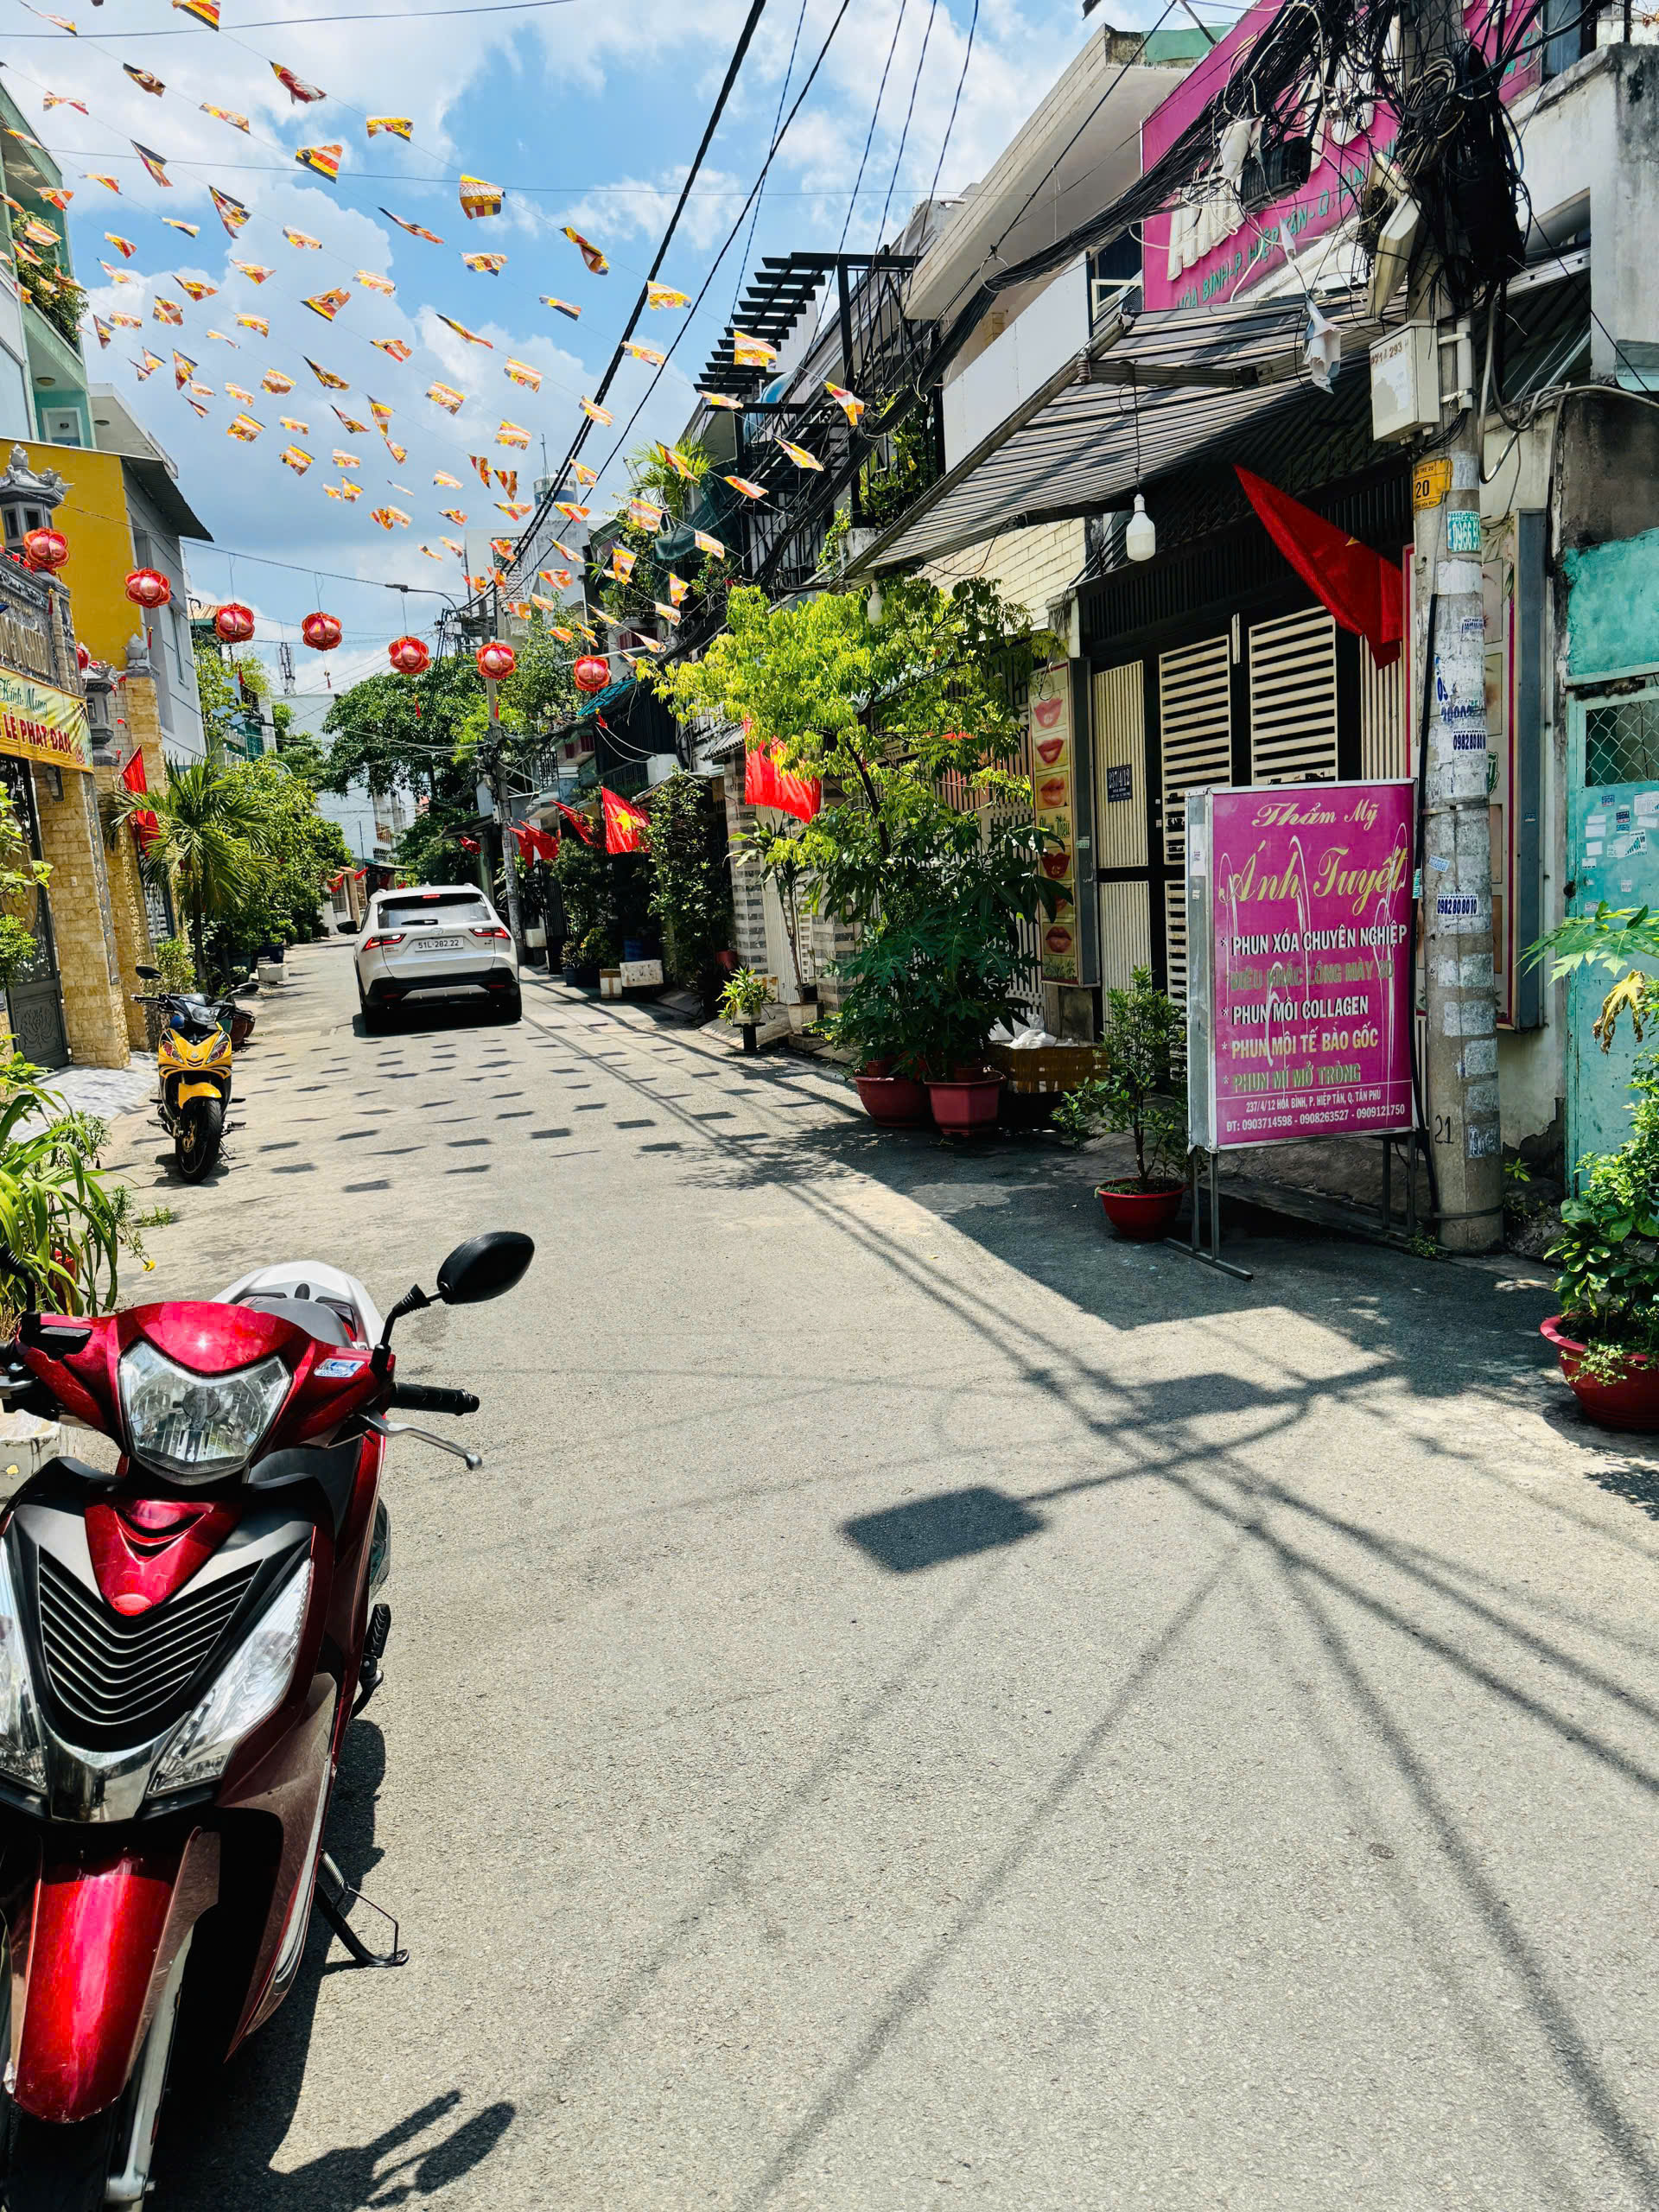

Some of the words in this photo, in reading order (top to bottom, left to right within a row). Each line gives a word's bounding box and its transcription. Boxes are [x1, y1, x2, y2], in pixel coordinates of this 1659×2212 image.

[1415, 480, 1430, 499] 20
[19, 718, 48, 752] PHẬT
[1251, 803, 1337, 827] Thẩm
[1344, 798, 1380, 830] Mỹ
[1218, 840, 1300, 903] Ánh
[1313, 844, 1408, 916] Tuyết
[1232, 934, 1268, 956] PHUN
[1273, 927, 1300, 953] XÓA
[1303, 924, 1356, 950] CHUYÊN
[1360, 919, 1408, 949] NGHIỆP
[1232, 1003, 1268, 1025] PHUN
[1273, 996, 1298, 1021] MÔI
[1302, 995, 1369, 1020] COLLAGEN
[1231, 1039, 1268, 1059] PHUN
[1272, 1031, 1296, 1056] MÔI
[1300, 1026, 1319, 1052] TẾ
[1322, 1026, 1349, 1051] BÀO
[1352, 1021, 1378, 1048] GỐC
[1233, 1071, 1269, 1093] PHUN
[1242, 1115, 1293, 1130] 0903714598
[1300, 1109, 1349, 1125] 0908263527
[1357, 1104, 1405, 1119] 0909121750
[1246, 1100, 1276, 1112] 237/4/12
[1435, 1115, 1454, 1144] 21
